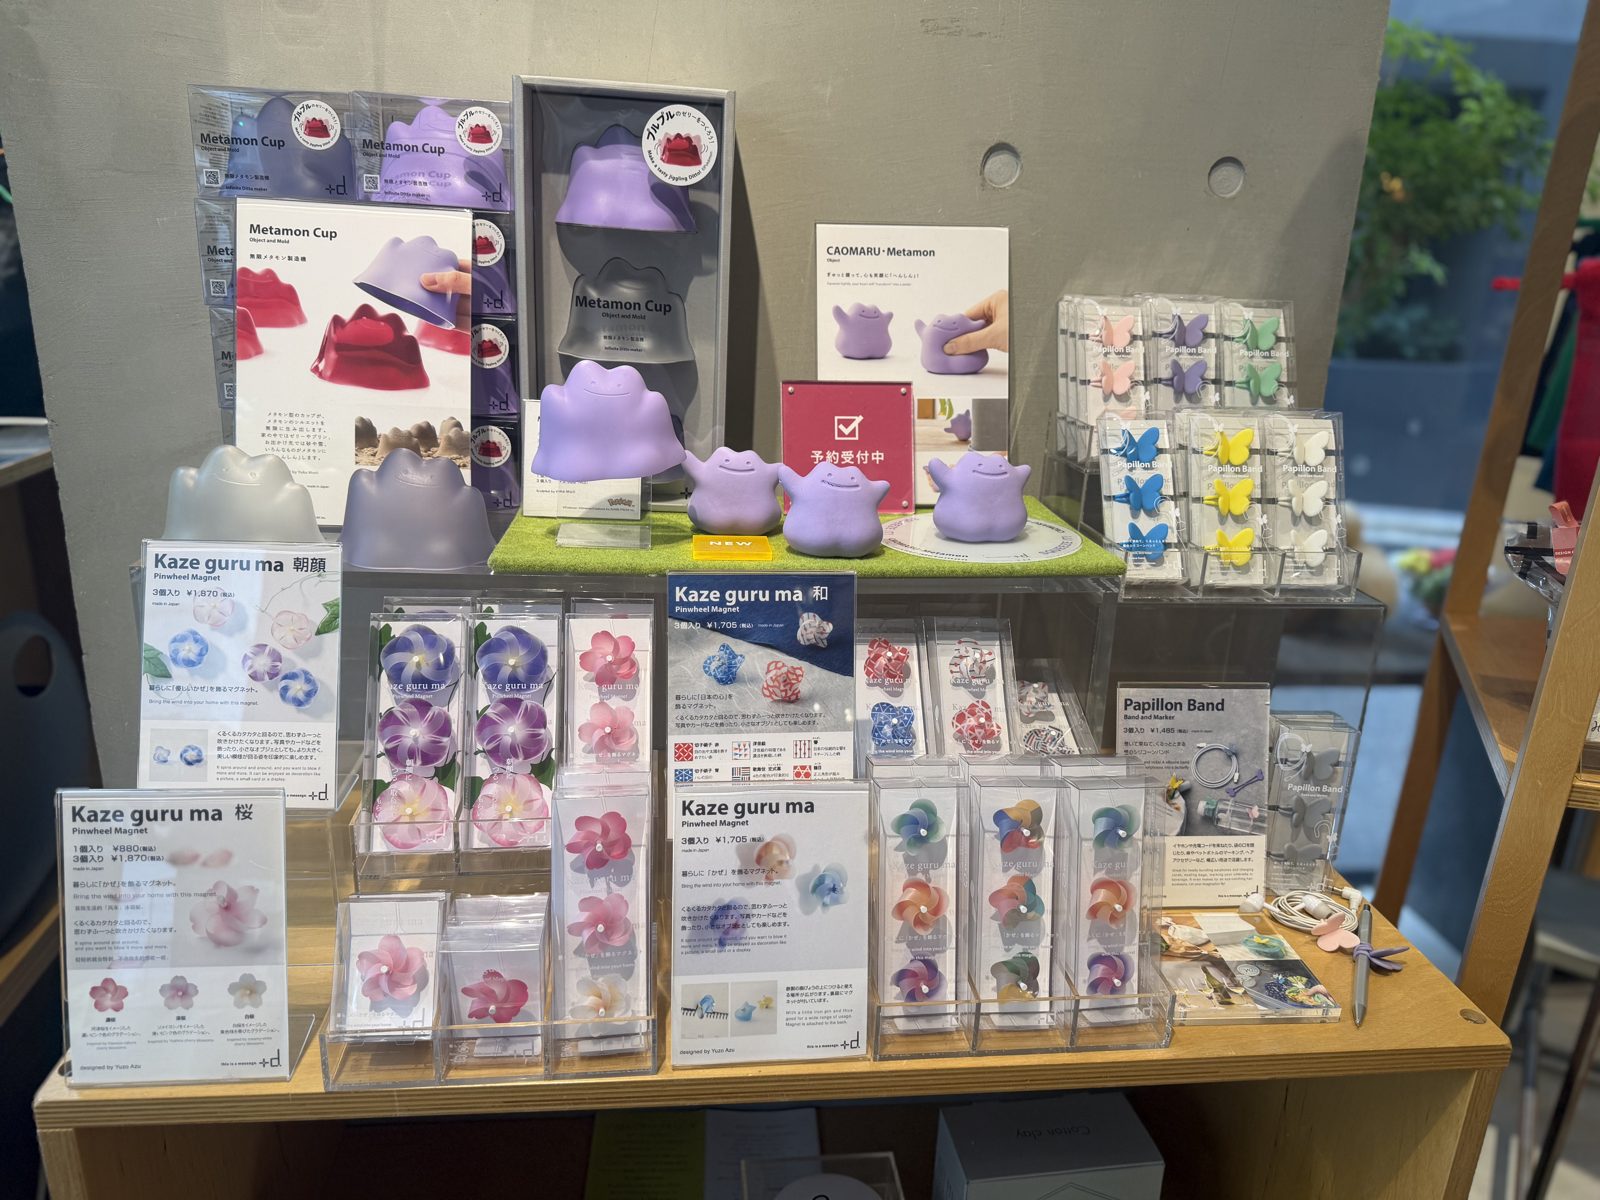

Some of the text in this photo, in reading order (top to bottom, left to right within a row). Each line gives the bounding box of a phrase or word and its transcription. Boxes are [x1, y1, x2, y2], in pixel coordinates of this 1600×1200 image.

[200, 133, 258, 146] Metamon
[261, 136, 285, 150] Cup
[362, 139, 419, 153] Metamon
[421, 143, 446, 157] Cup
[249, 223, 338, 241] Metamon Cup
[575, 295, 672, 316] Metamon Cup
[601, 312, 620, 320] Object
[1092, 346, 1124, 354] Papillon
[1165, 345, 1217, 354] Papillon Band
[1239, 349, 1289, 359] Papillon Band
[810, 449, 885, 465] 予約受付中
[1117, 460, 1172, 470] Papillon Band
[1208, 464, 1263, 474] Papillon Band
[1282, 463, 1337, 474] Papillon Band
[154, 553, 327, 574] Kaze guru ma 朝顔
[153, 573, 221, 583] Pinwheel Magnet
[152, 588, 180, 597] 3個入り
[186, 589, 219, 598] ¥1,870
[675, 585, 828, 606] Kaze guru ma 和
[711, 605, 740, 614] Magnet
[673, 621, 701, 629] 3個入り
[706, 621, 737, 629] ¥1,705
[406, 682, 446, 691] guru ma
[505, 682, 527, 691] guru
[529, 682, 544, 690] ma
[601, 684, 623, 693] guru
[675, 702, 717, 710] 飾るマグネット。
[1123, 697, 1225, 715] Papillon Band
[1287, 782, 1343, 794] Papillon Band
[681, 800, 815, 819] Kaze guru ma
[71, 803, 253, 827] Kaze guru ma 桜
[681, 819, 749, 828] Pinwheel Magnet
[72, 827, 148, 837] Pinwheel Magnet
[681, 837, 710, 845] 3個入り
[715, 835, 748, 844] ¥1,705
[73, 845, 104, 853] 1個入り
[73, 854, 104, 863] 3個入り
[917, 862, 939, 871] guru
[1016, 862, 1038, 870] guru
[1045, 1125, 1090, 1137] Cotton
